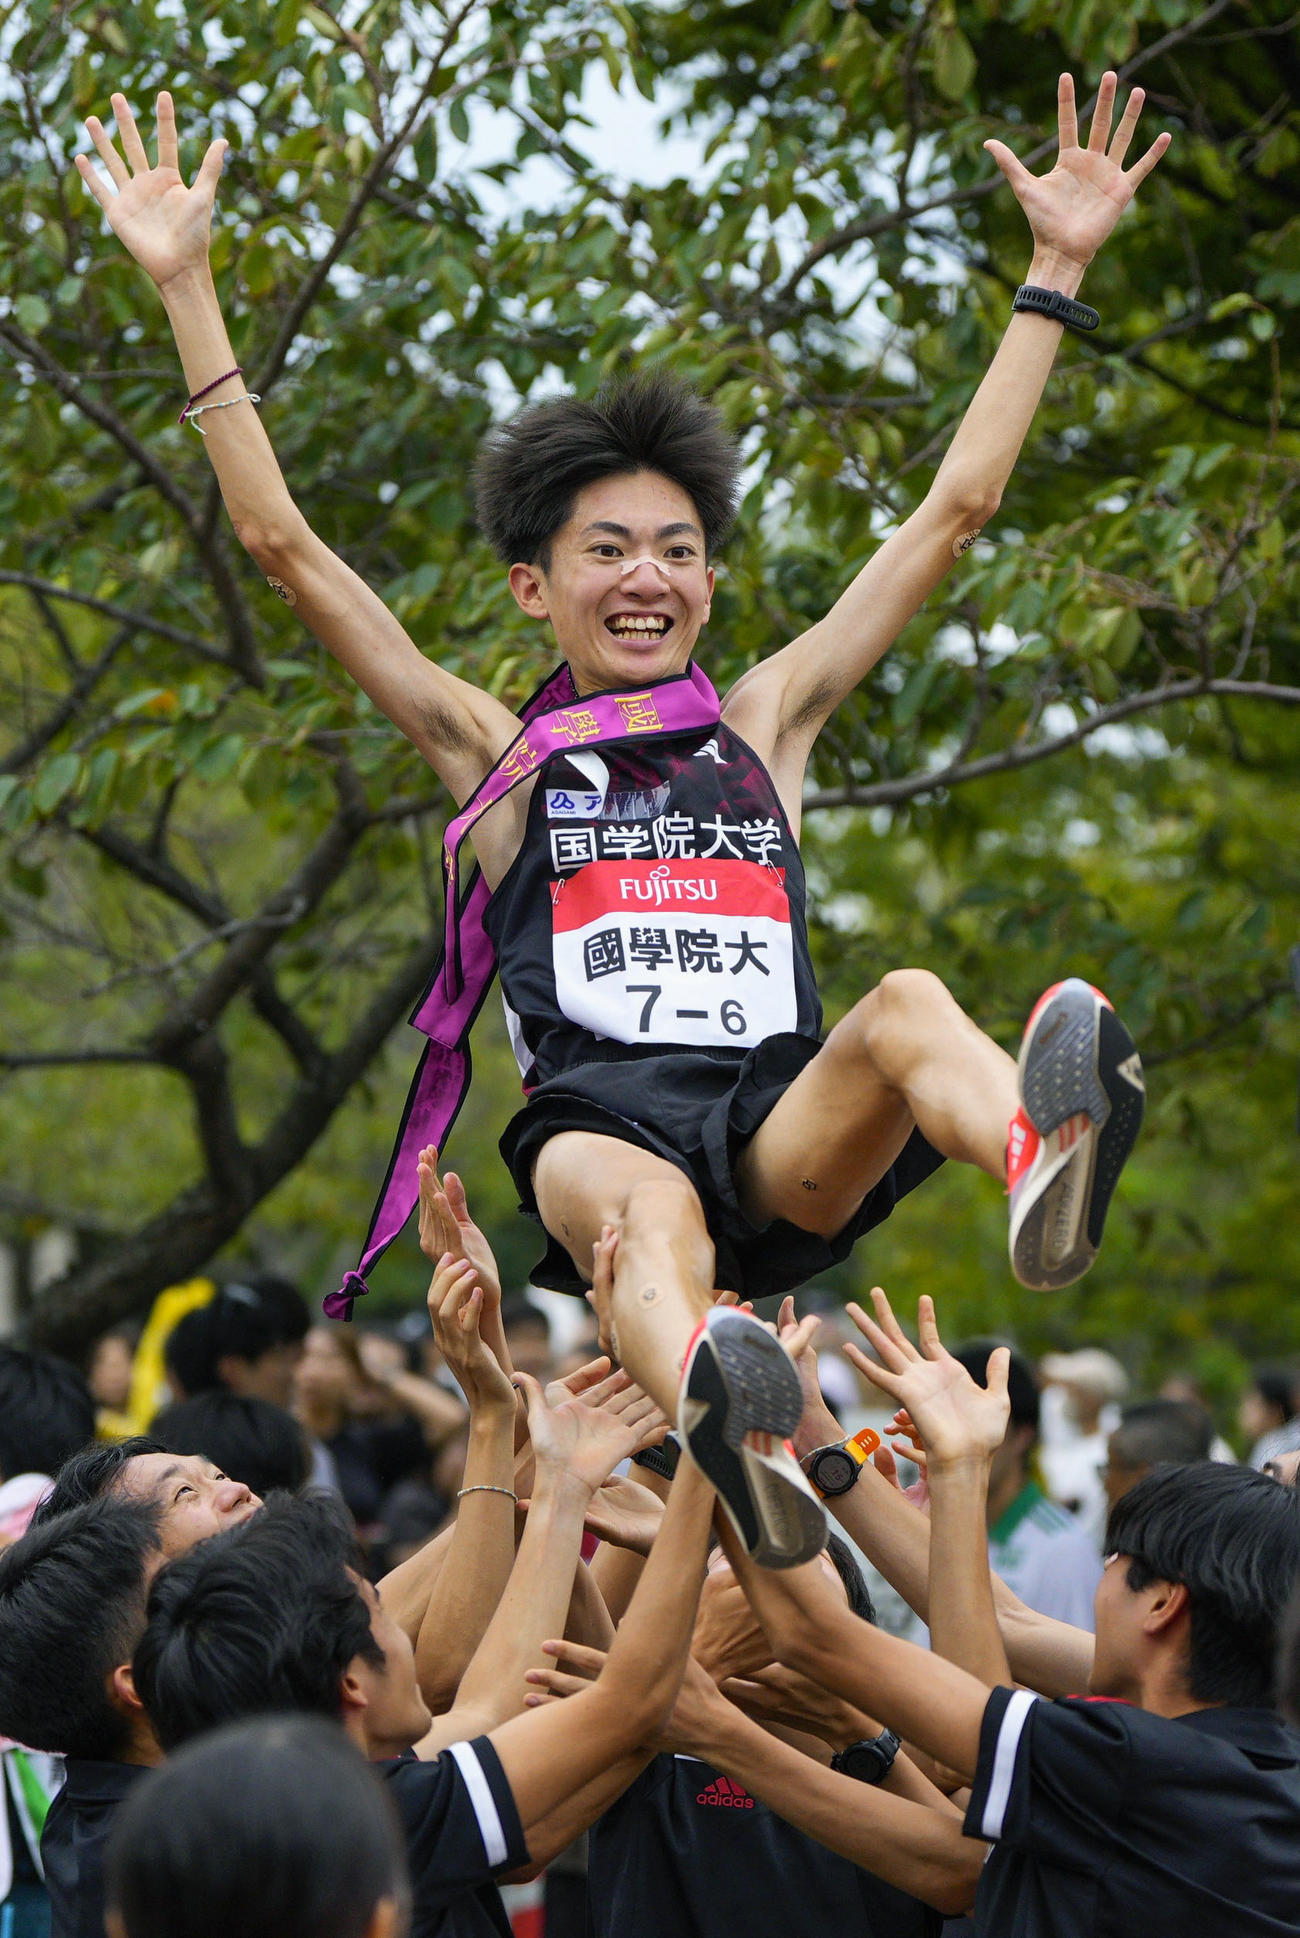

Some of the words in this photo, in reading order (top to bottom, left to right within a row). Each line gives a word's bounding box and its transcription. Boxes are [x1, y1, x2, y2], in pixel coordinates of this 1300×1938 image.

[550, 811, 782, 873] 国学院大学
[619, 866, 718, 906] FUJITSU
[584, 926, 771, 982] 國學院大
[696, 1793, 754, 1808] adidas
